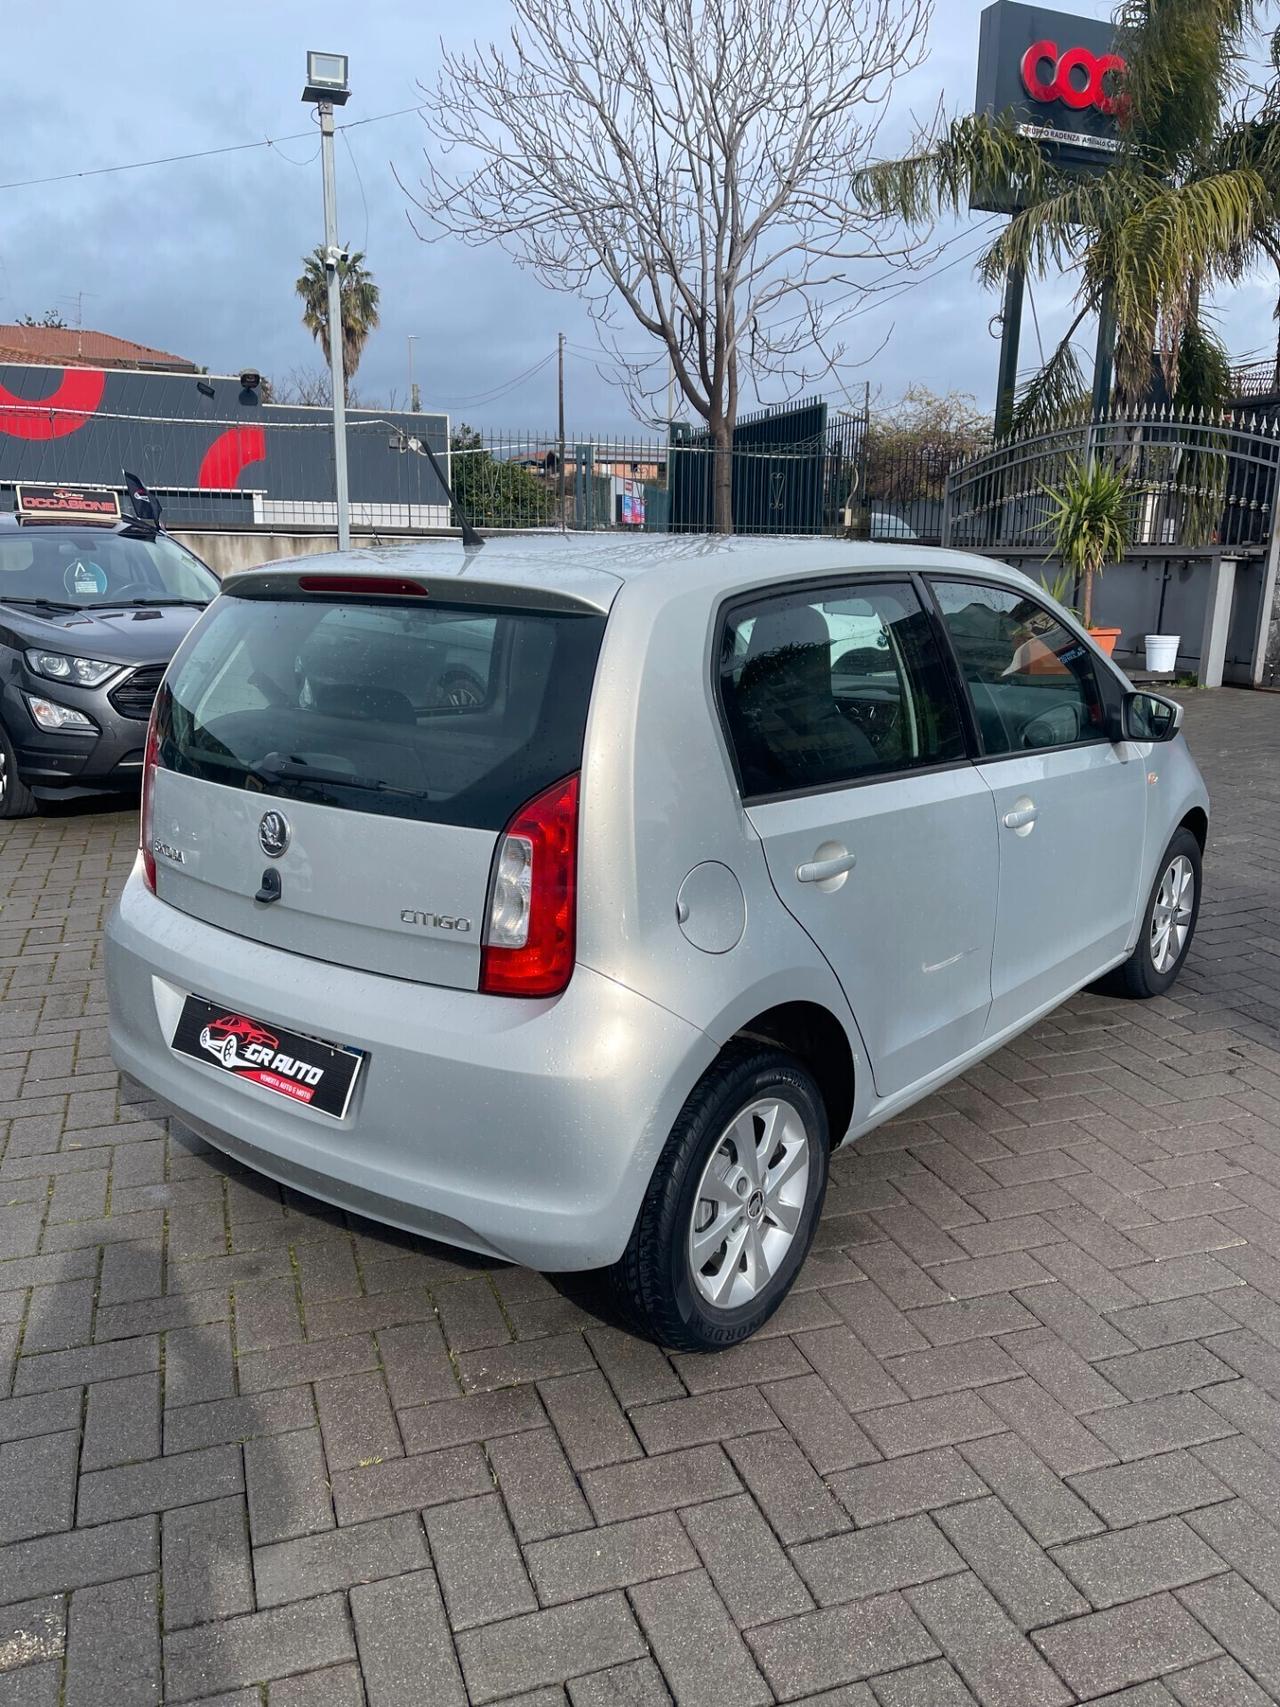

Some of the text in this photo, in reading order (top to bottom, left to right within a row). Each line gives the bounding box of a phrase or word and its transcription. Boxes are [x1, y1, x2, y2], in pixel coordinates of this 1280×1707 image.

[22, 498, 115, 512] OCCASIONE
[400, 909, 470, 932] CITIGO
[243, 1043, 325, 1086] GR AUTO
[279, 1081, 293, 1093] AUTO
[296, 1088, 312, 1100] MOTO
